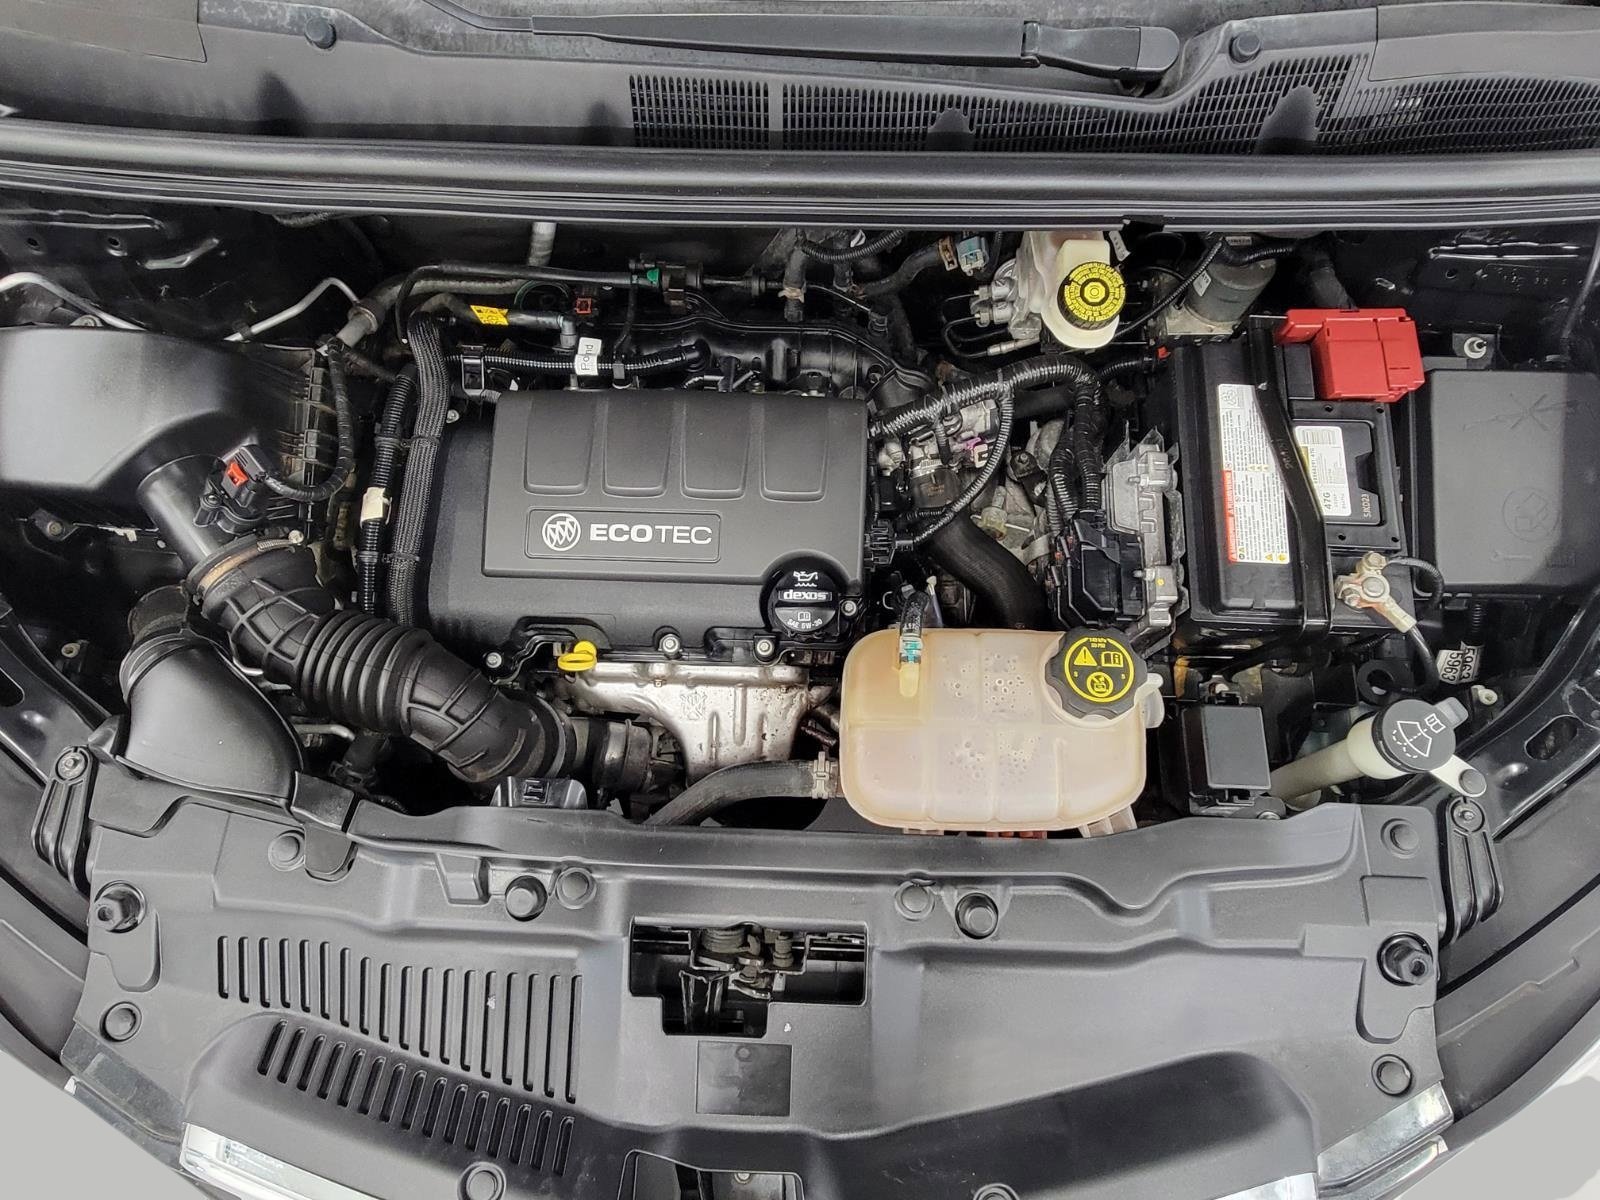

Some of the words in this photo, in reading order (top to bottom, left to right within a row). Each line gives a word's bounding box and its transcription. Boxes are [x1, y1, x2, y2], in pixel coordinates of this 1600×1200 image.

[1322, 492, 1332, 510] 47G
[589, 523, 713, 545] ECOTEC
[783, 589, 829, 600] dexos
[787, 618, 799, 629] SAE
[801, 618, 823, 629] 5W-30
[1441, 652, 1464, 682] 5963
